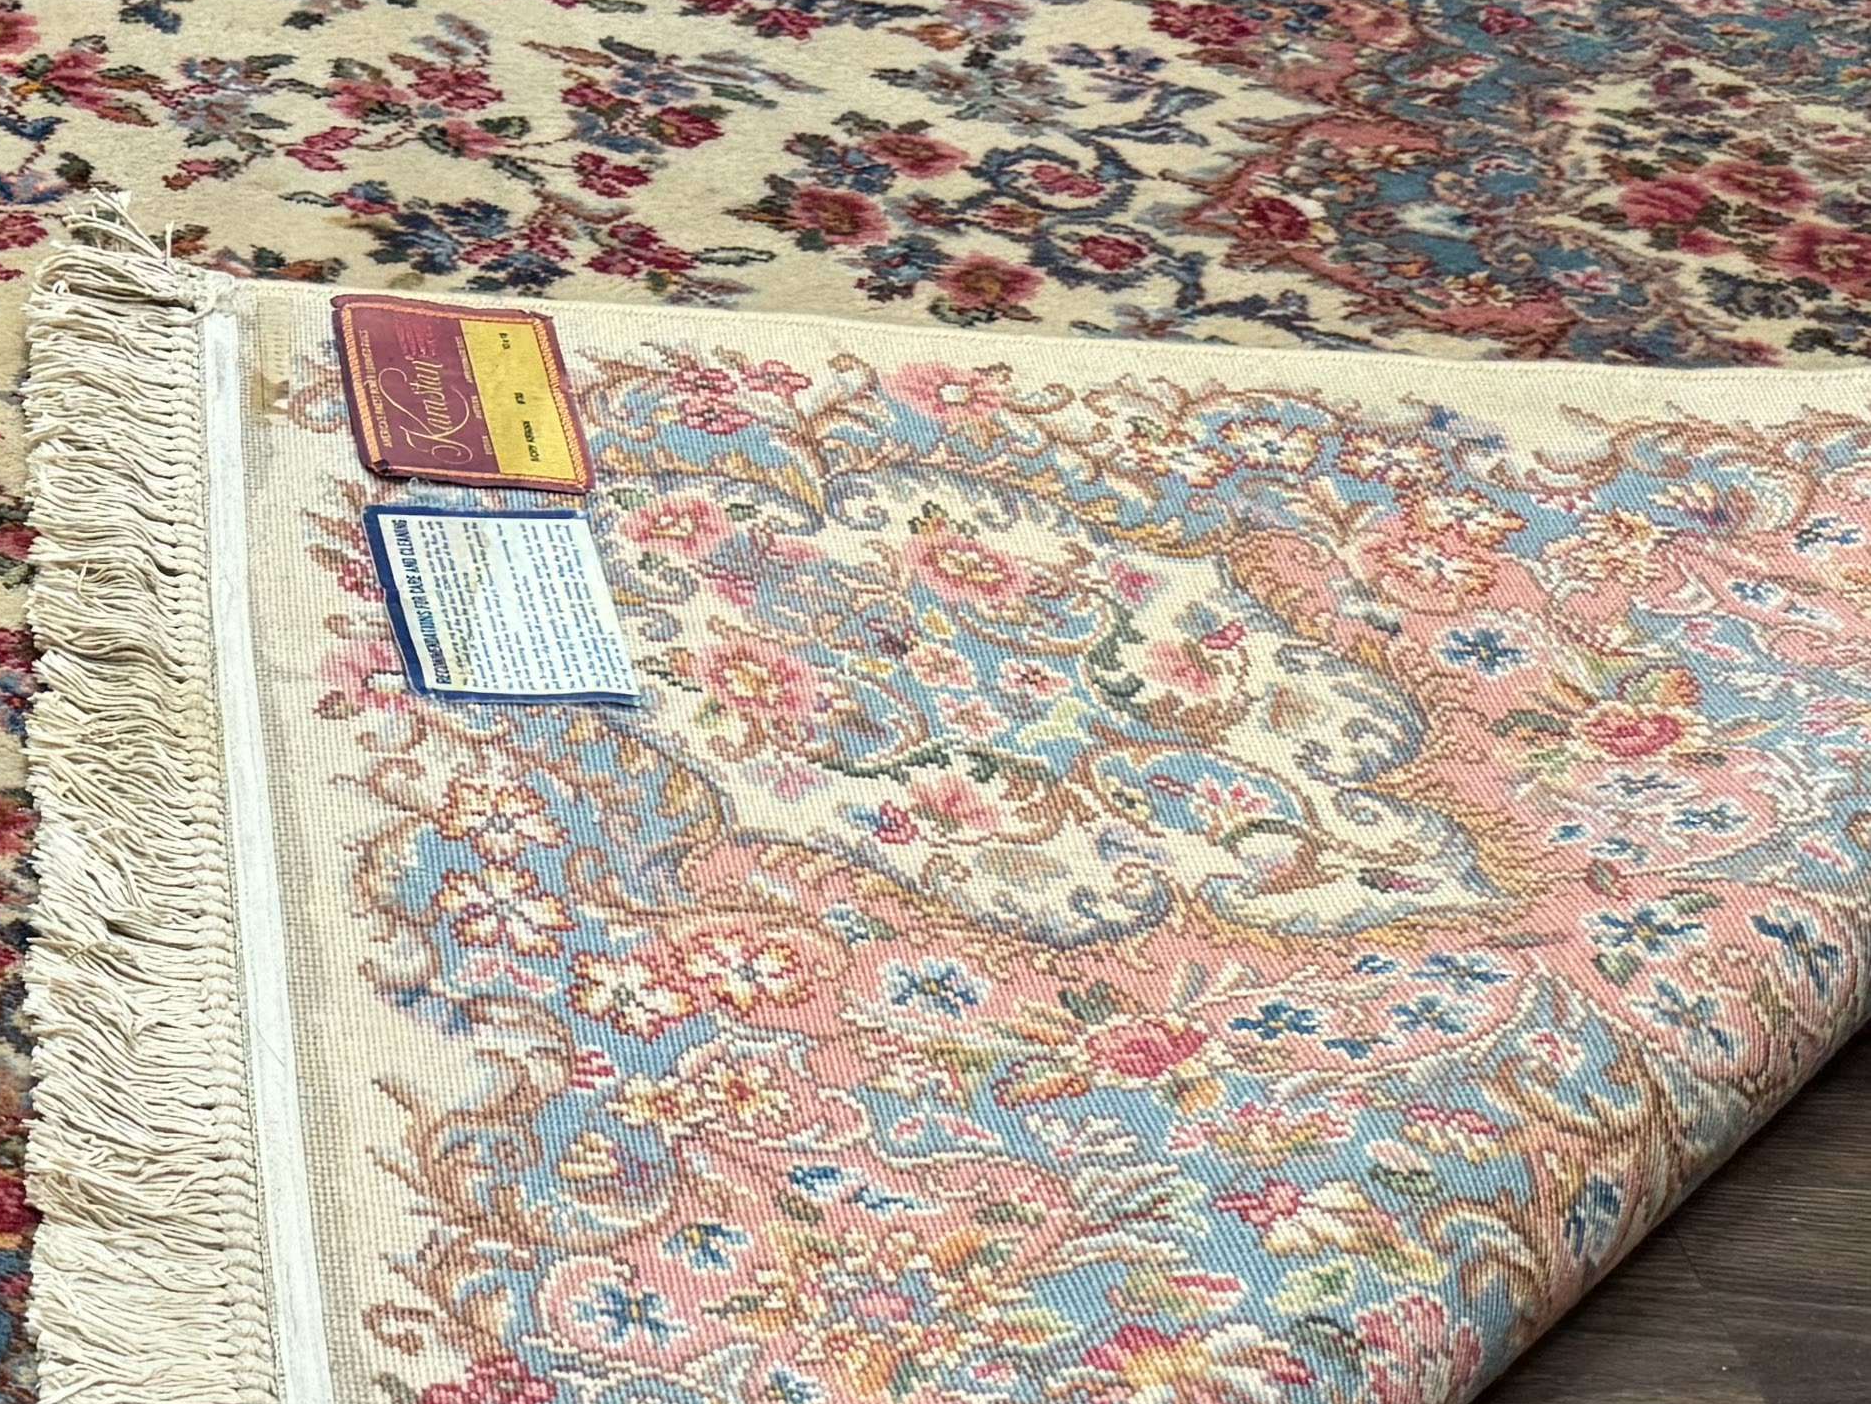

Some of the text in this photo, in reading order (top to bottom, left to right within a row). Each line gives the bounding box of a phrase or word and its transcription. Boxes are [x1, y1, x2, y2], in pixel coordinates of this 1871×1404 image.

[391, 519, 452, 683] RECOMMENDATIONS FOR CARE AND CLEANING
